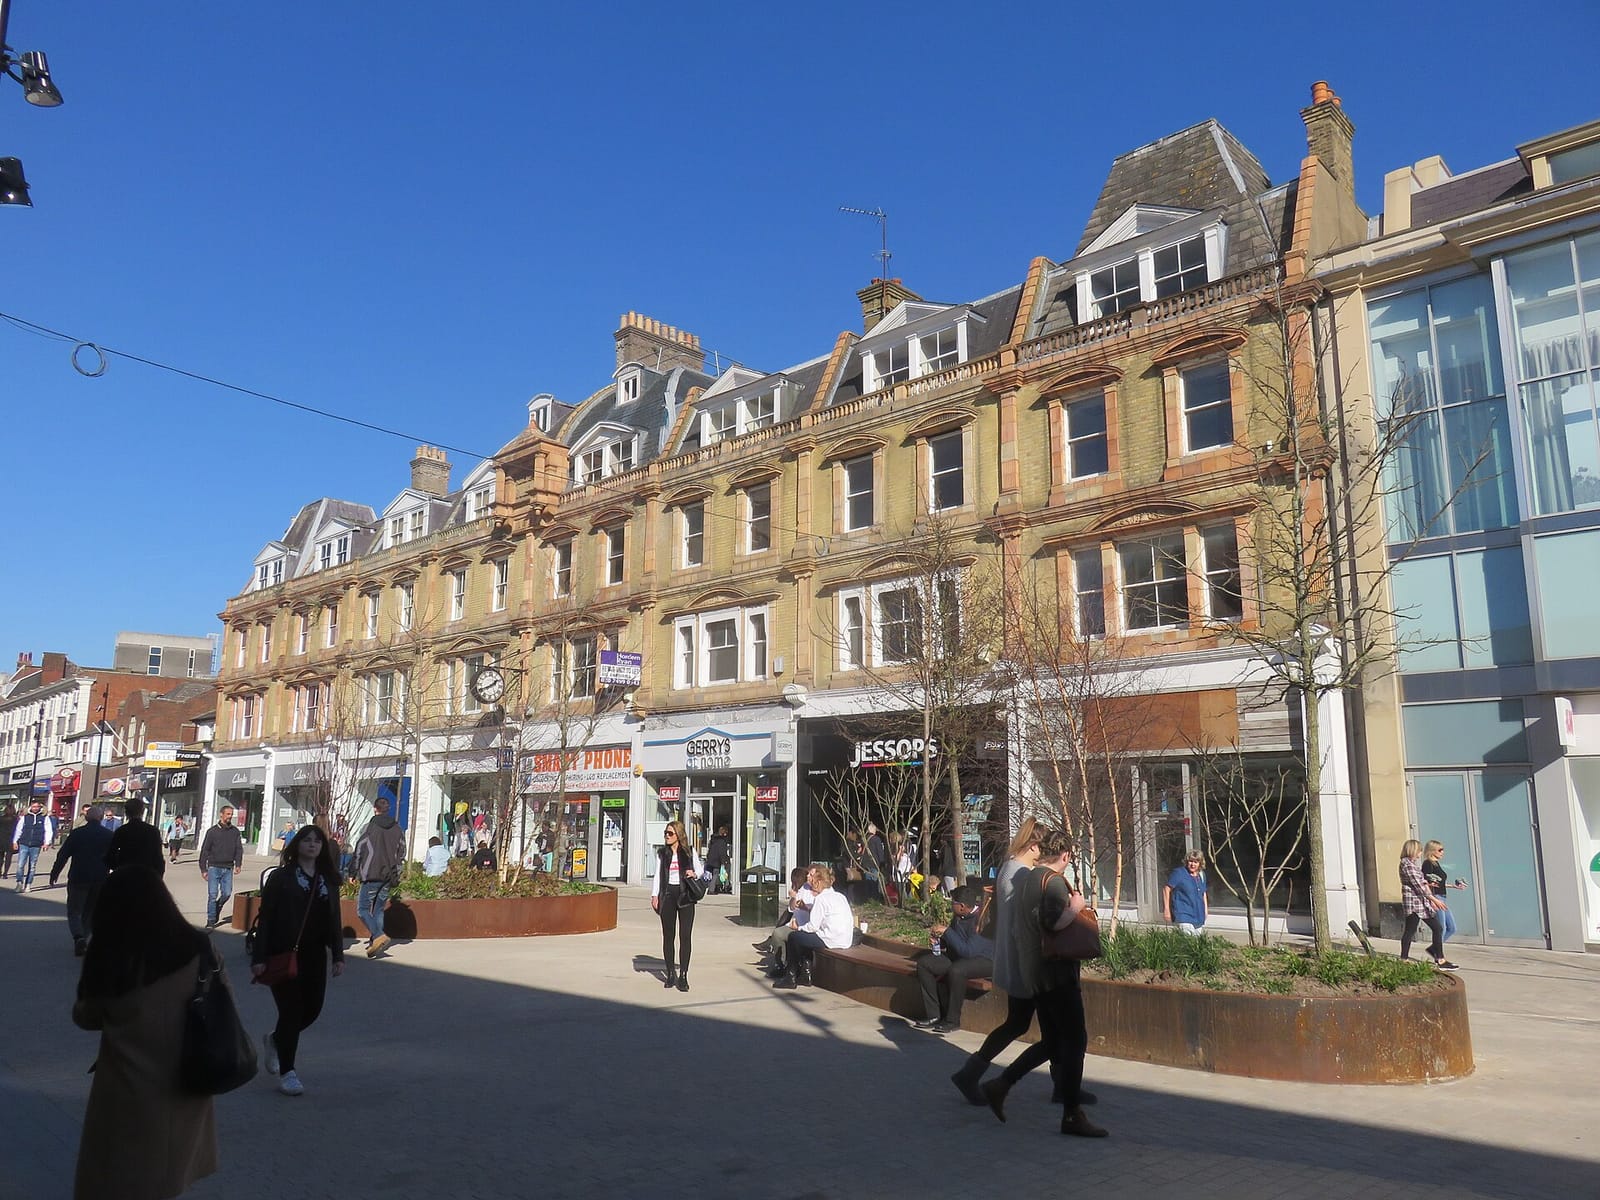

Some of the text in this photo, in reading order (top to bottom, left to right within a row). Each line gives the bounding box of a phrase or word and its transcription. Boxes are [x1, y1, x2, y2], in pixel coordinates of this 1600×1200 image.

[686, 738, 731, 756] GERRYS
[850, 737, 938, 768] JESSOPS
[583, 749, 631, 769] PHONE
[660, 789, 679, 799] SALE
[757, 789, 778, 799] SALE
